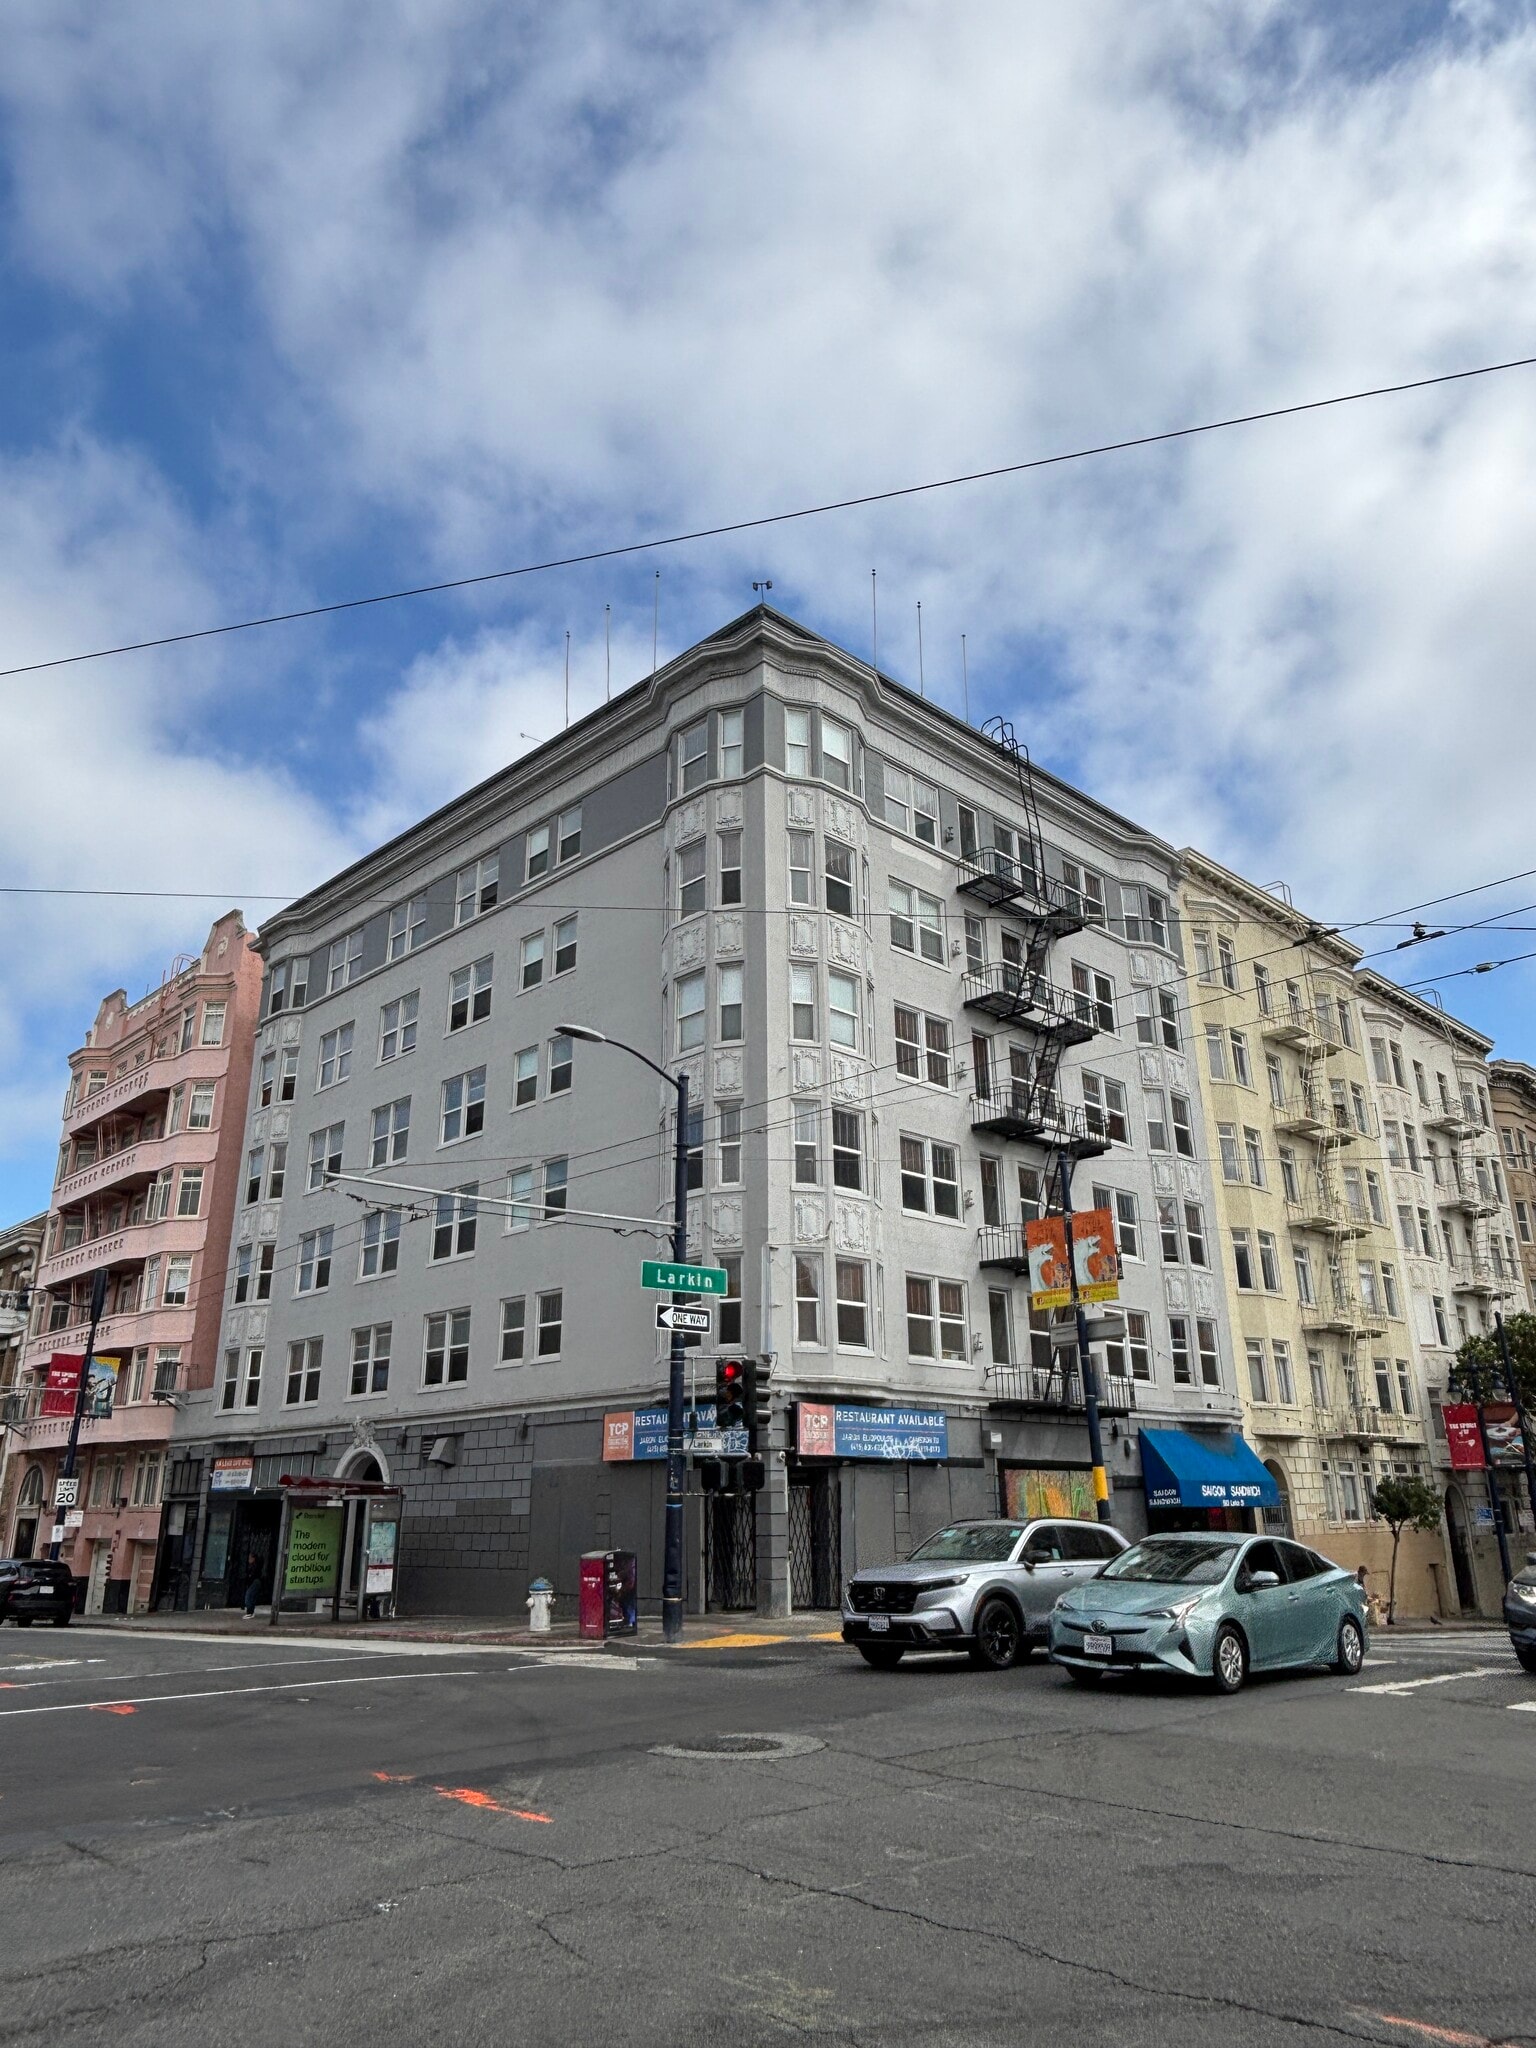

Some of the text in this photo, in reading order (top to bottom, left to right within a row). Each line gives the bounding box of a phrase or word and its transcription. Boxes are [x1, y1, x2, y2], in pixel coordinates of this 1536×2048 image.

[657, 1268, 713, 1288] Larkin
[671, 1312, 706, 1325] ONE WAY
[804, 1414, 829, 1429] TCP
[836, 1410, 945, 1427] RESTAURANT AVAILABLE
[608, 1422, 629, 1436] TCP
[693, 1440, 713, 1448] Larkin
[1153, 1488, 1177, 1497] SAIGON
[1201, 1484, 1261, 1497] SAIGON SANDWICH
[56, 1492, 75, 1503] 20
[295, 1529, 311, 1539] The
[293, 1541, 327, 1550] modern
[291, 1551, 330, 1561] cloud for
[290, 1563, 332, 1573] ambitious
[289, 1575, 324, 1585] startups
